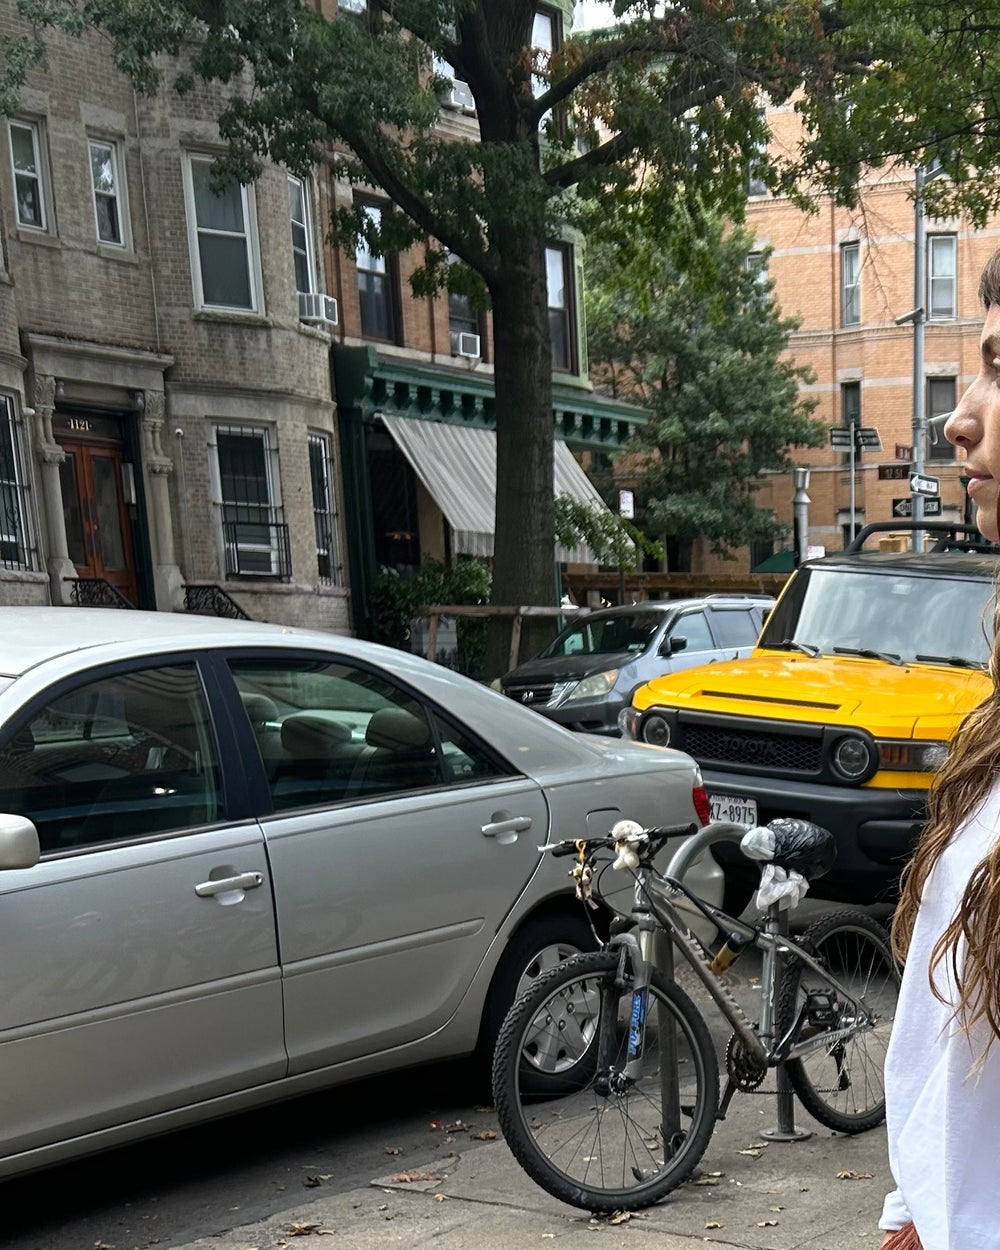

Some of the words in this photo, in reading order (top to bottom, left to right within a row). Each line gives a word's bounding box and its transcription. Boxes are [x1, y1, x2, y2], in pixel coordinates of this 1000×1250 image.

[70, 418, 90, 431] 1121
[723, 736, 777, 755] TOYOTA
[728, 804, 755, 825] 8975
